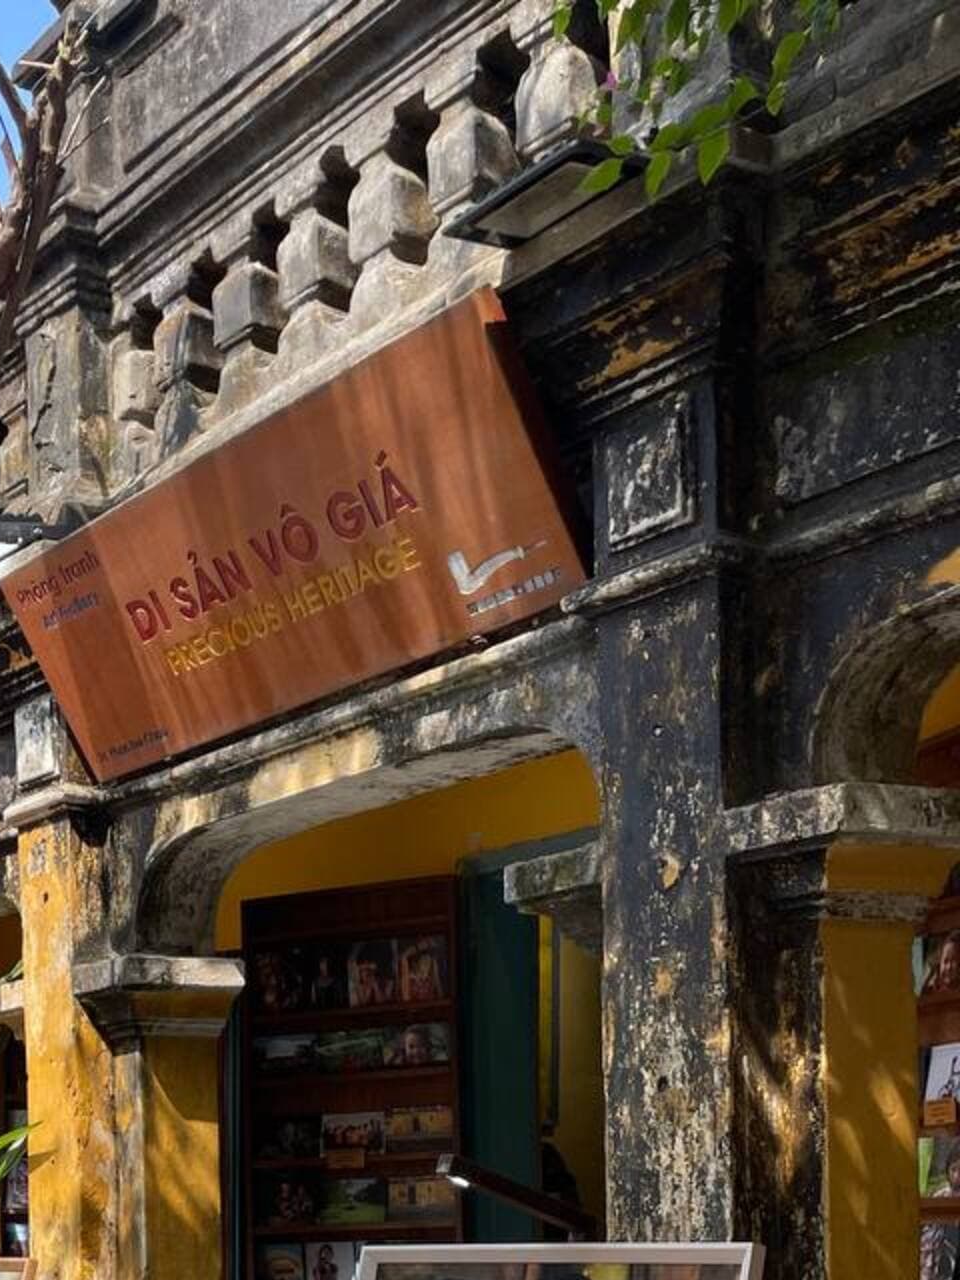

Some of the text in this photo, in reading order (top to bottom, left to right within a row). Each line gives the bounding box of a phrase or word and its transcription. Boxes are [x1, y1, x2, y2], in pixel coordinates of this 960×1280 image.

[125, 589, 173, 642] DI
[169, 550, 253, 619] SẢN
[248, 504, 318, 578] VÔ
[325, 450, 418, 541] GIÁ
[164, 603, 283, 675] PRECIOUS
[283, 539, 423, 623] HERITAGE
